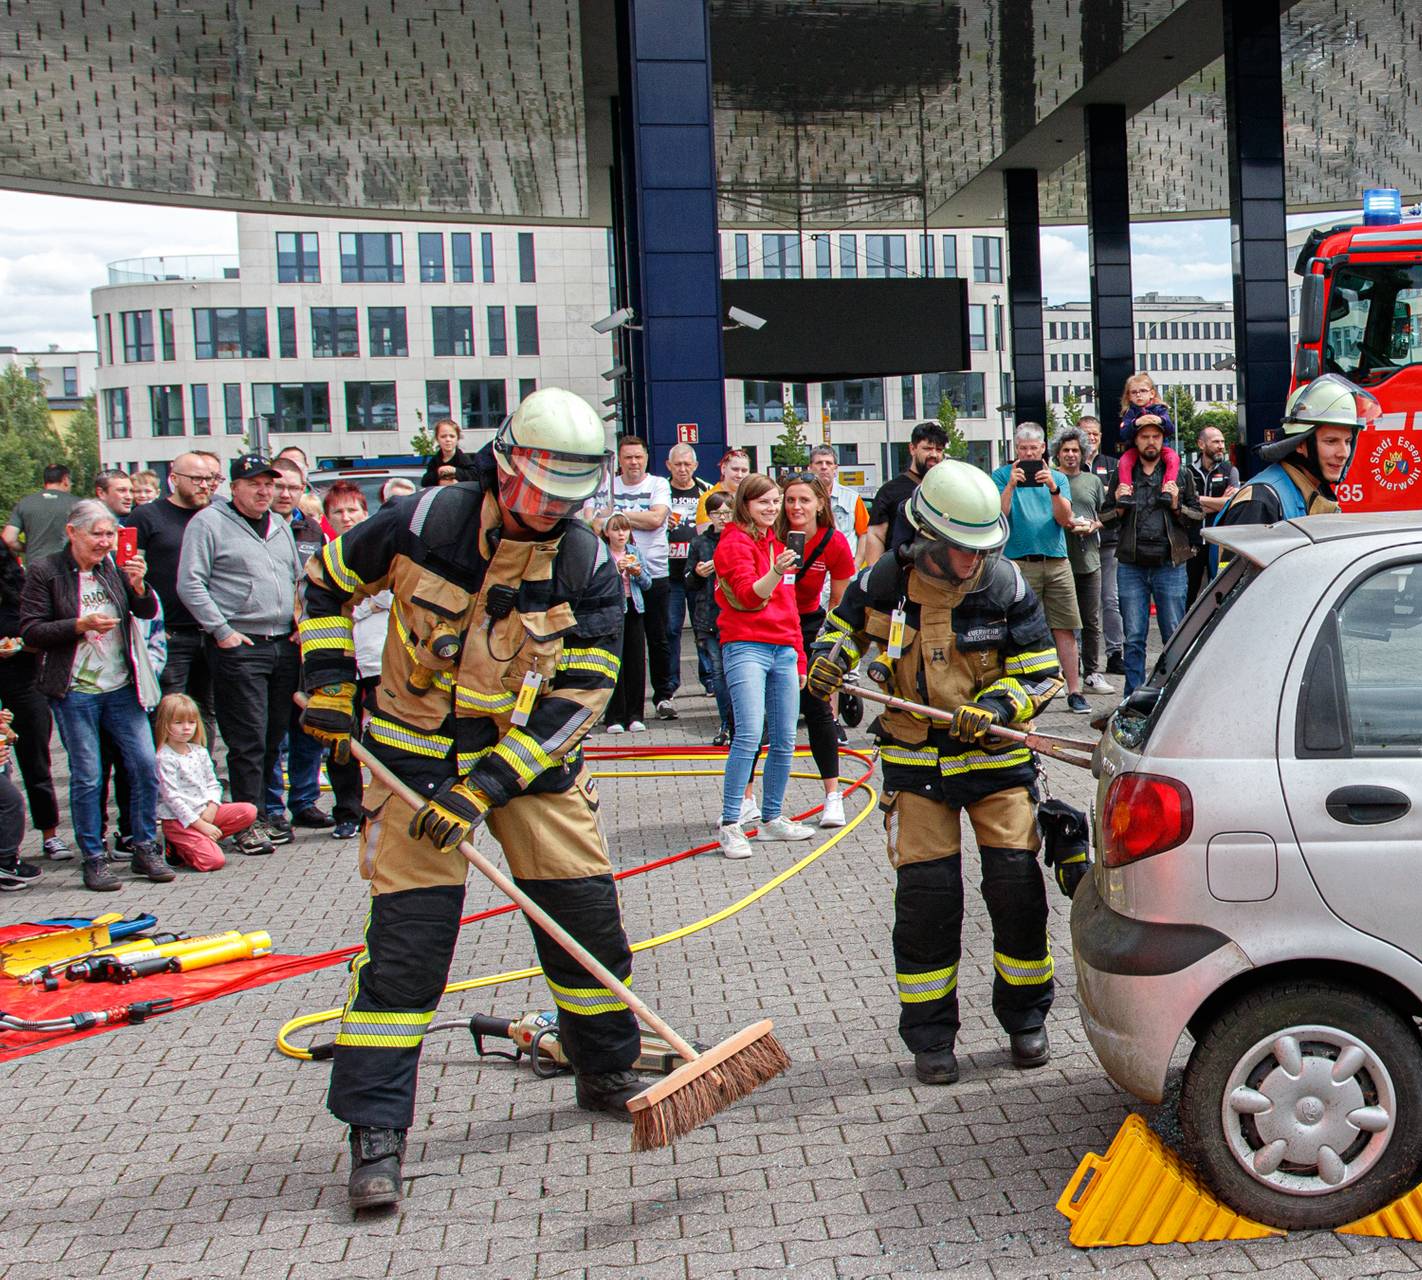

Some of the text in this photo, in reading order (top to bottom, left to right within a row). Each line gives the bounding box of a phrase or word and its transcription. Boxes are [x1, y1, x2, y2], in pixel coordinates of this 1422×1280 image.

[1369, 436, 1422, 464] Stadt Essen
[1371, 467, 1422, 491] Feuerwehr
